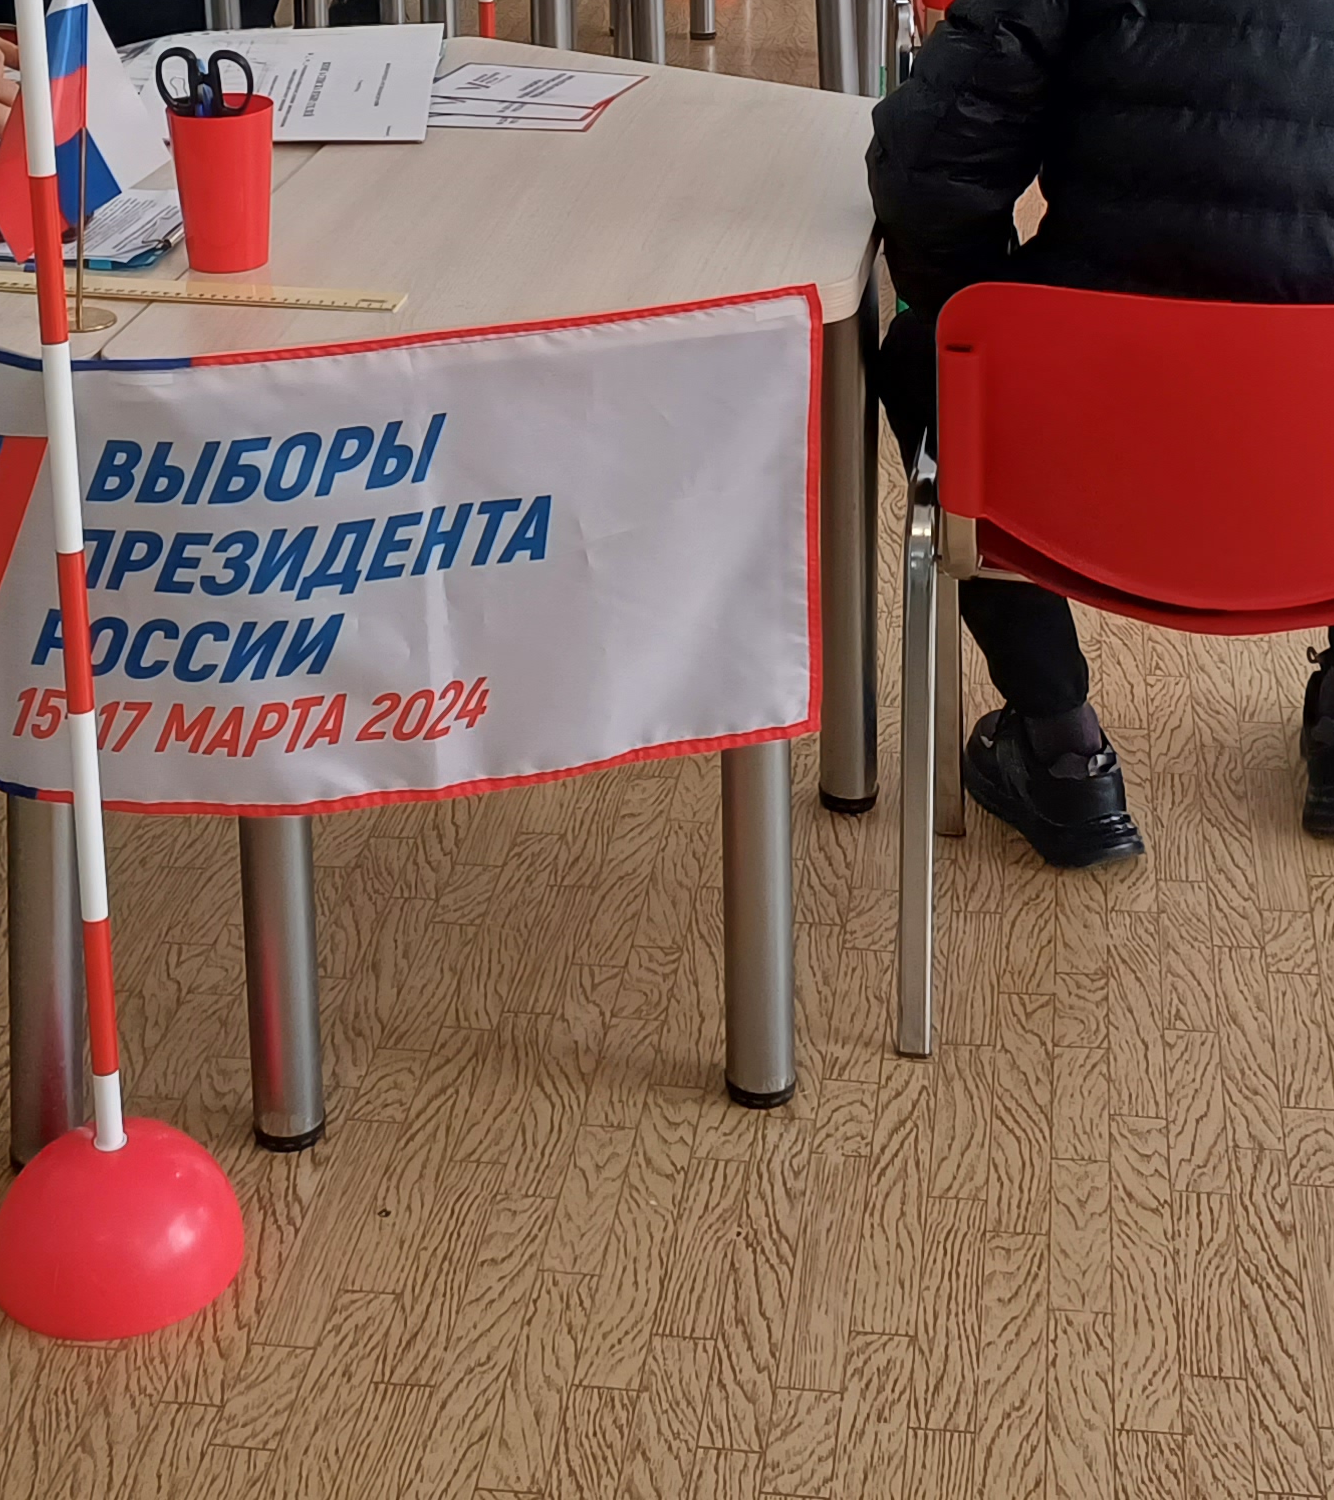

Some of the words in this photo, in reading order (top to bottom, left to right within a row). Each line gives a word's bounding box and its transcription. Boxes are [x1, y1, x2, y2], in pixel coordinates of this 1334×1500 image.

[85, 412, 447, 505] ВЫБОРЫ
[82, 494, 553, 602] ПРЕЗИДЕНТА
[12, 686, 152, 753] 1517
[154, 693, 348, 759] МАРТА
[355, 676, 490, 742] 2024
